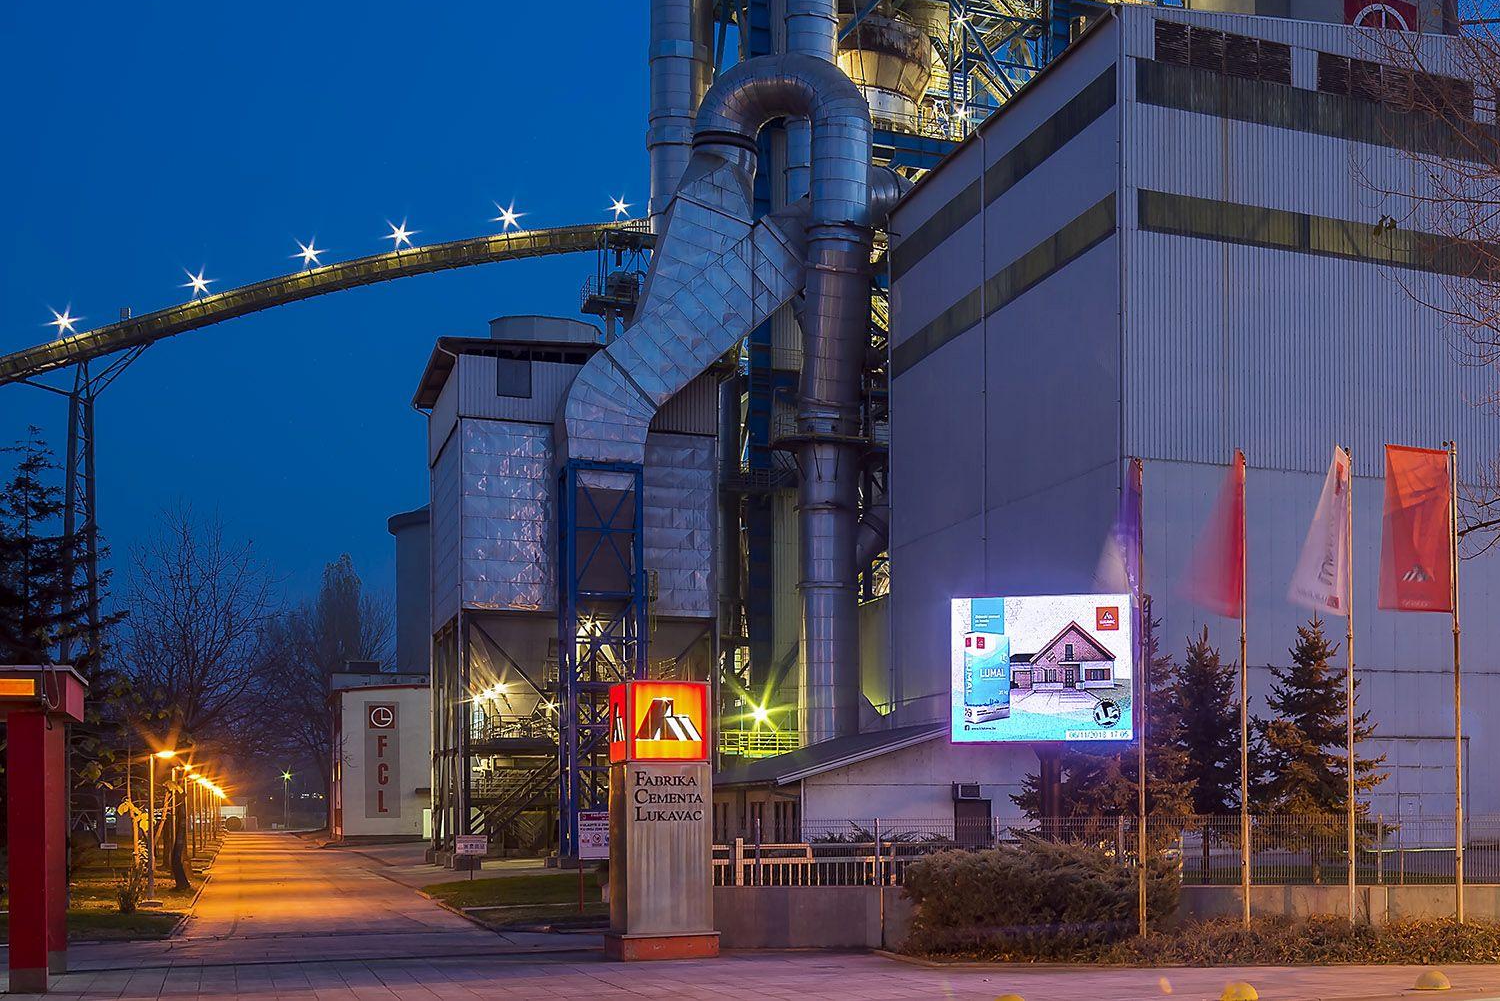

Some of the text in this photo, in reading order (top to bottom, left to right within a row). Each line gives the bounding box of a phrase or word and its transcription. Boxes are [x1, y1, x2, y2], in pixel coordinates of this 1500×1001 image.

[980, 668, 1006, 678] LUMAL
[634, 771, 697, 787] FABRIKA
[634, 789, 704, 804] CEMENTA
[634, 806, 703, 822] LUKAVAC
